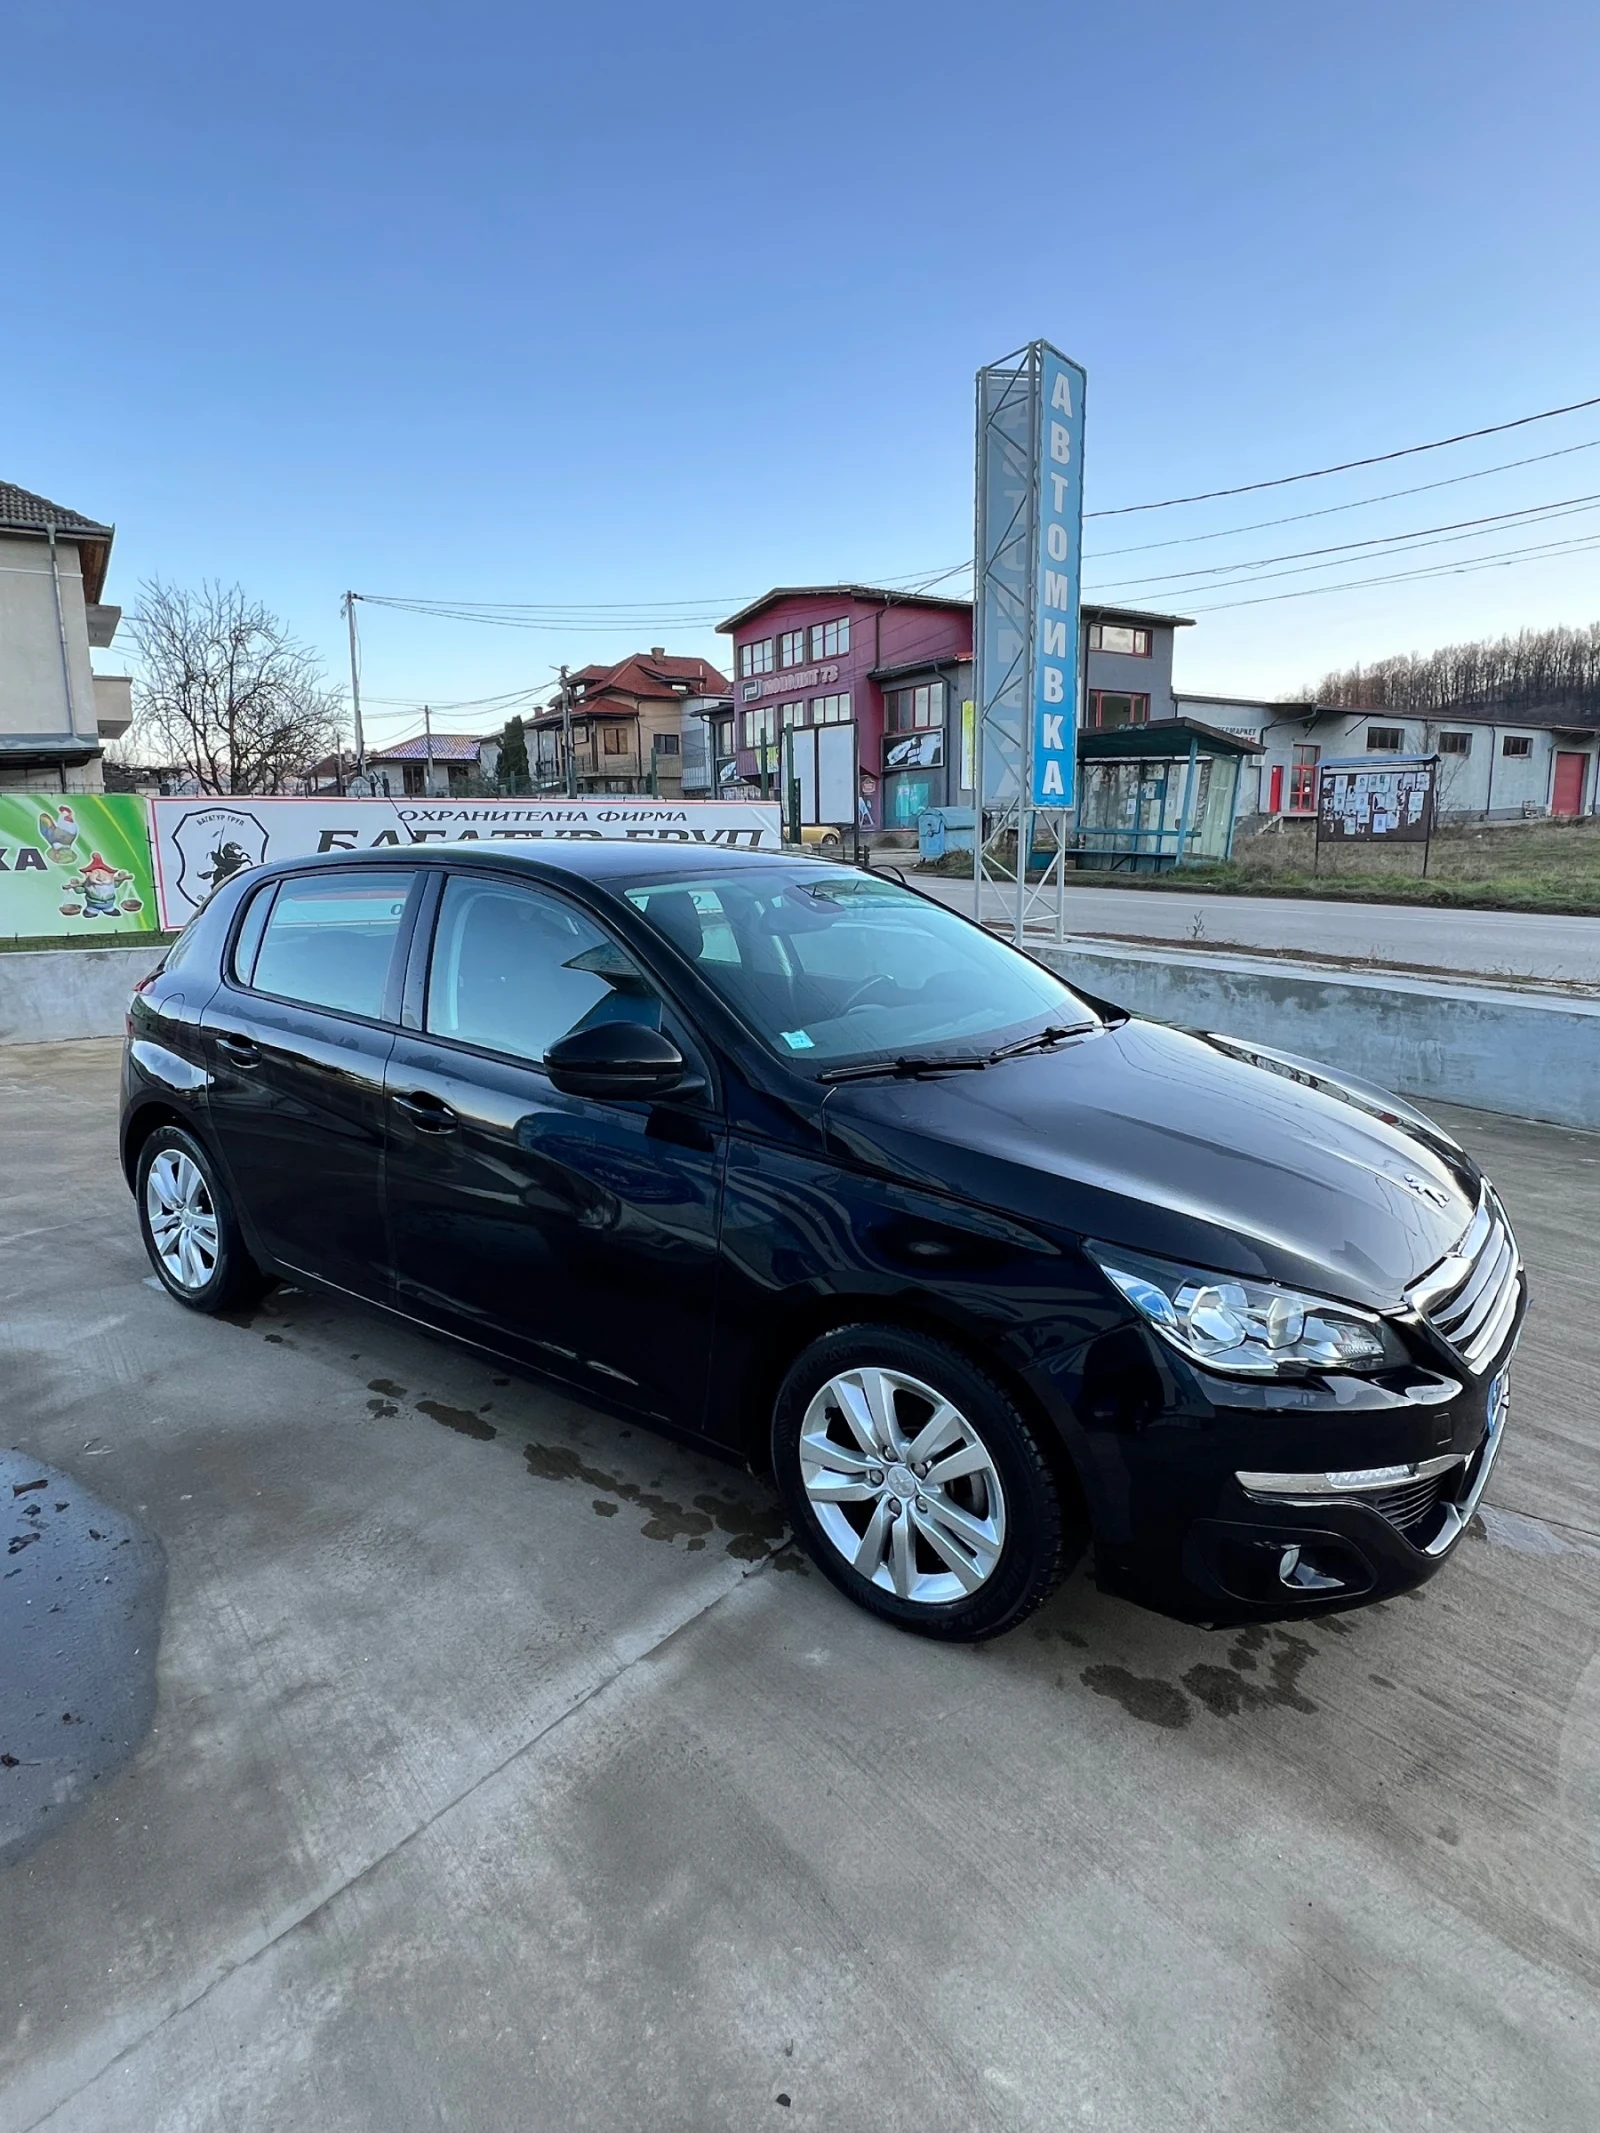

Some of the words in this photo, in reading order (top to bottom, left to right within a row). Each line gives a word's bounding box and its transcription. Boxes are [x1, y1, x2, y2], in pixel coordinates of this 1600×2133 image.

[1043, 371, 1073, 796] АВТОМИВКА
[819, 664, 839, 684] 73
[227, 815, 245, 826] ГРУП
[397, 810, 588, 822] ОХРАНИТЕЛНА
[596, 810, 687, 823] ФИРМА
